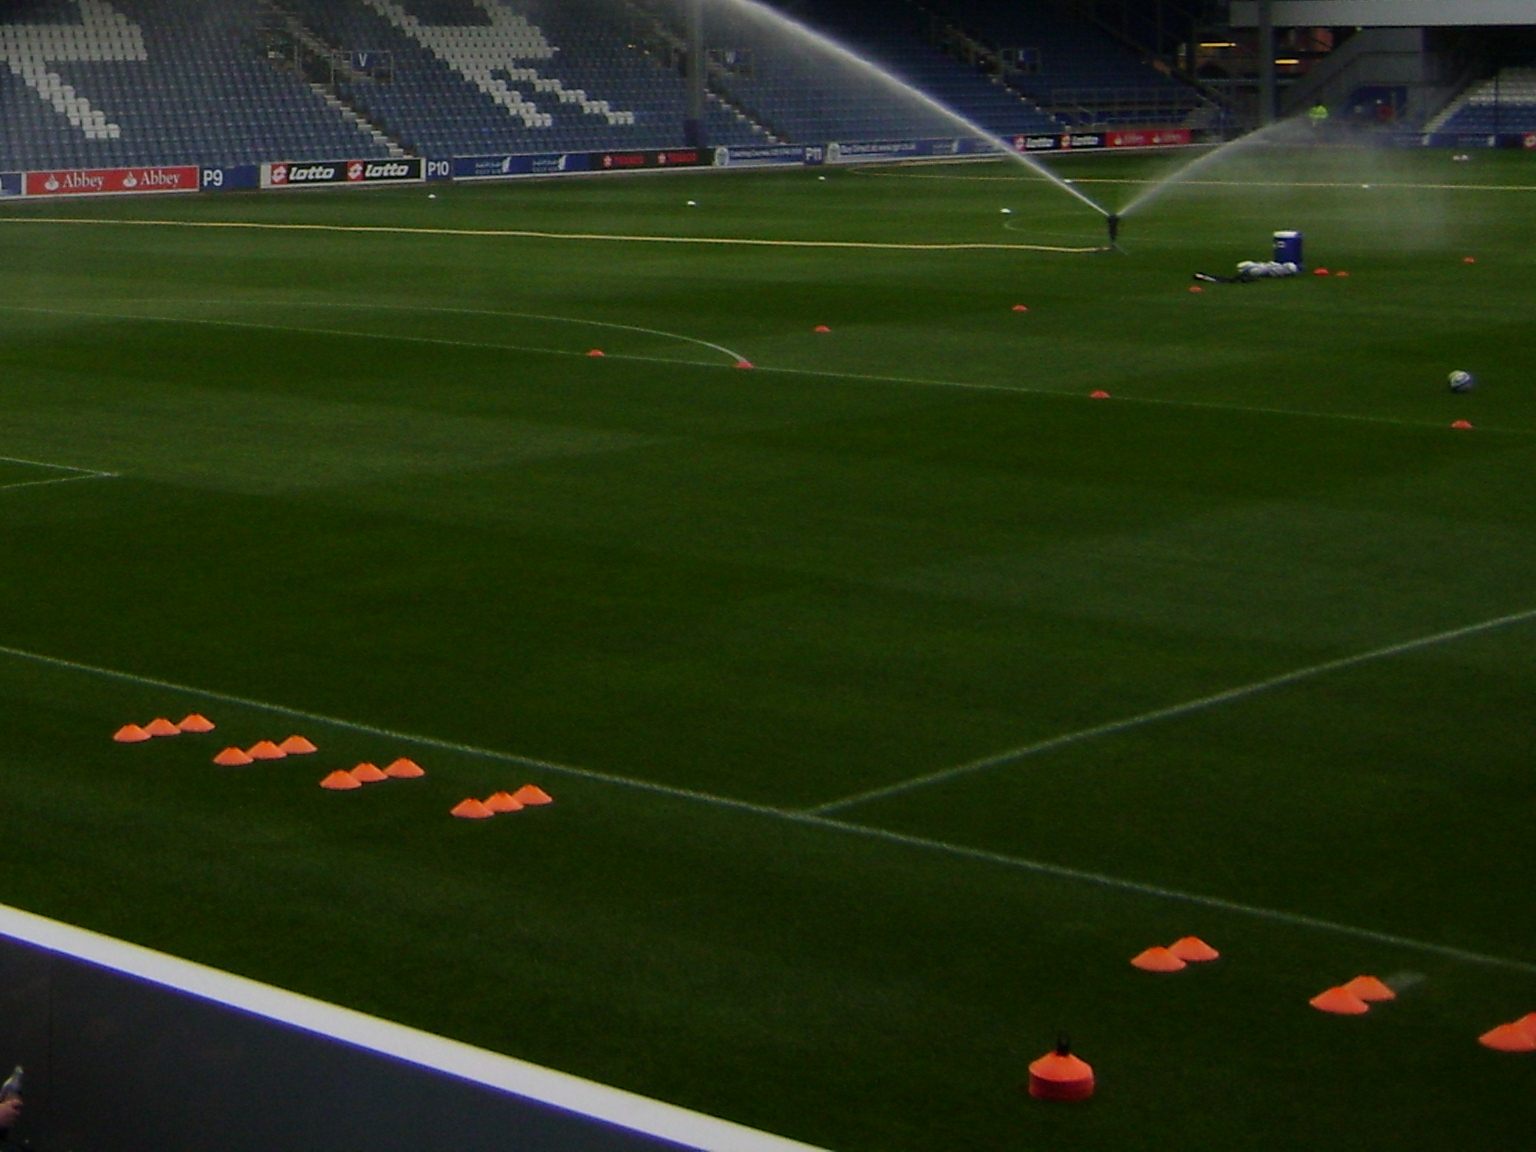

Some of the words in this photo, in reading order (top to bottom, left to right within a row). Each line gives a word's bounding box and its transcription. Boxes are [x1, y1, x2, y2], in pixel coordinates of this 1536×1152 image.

[358, 52, 368, 67] V
[427, 160, 450, 176] P10
[62, 171, 105, 191] Abbey
[139, 169, 181, 189] Abbey
[202, 169, 224, 187] P9
